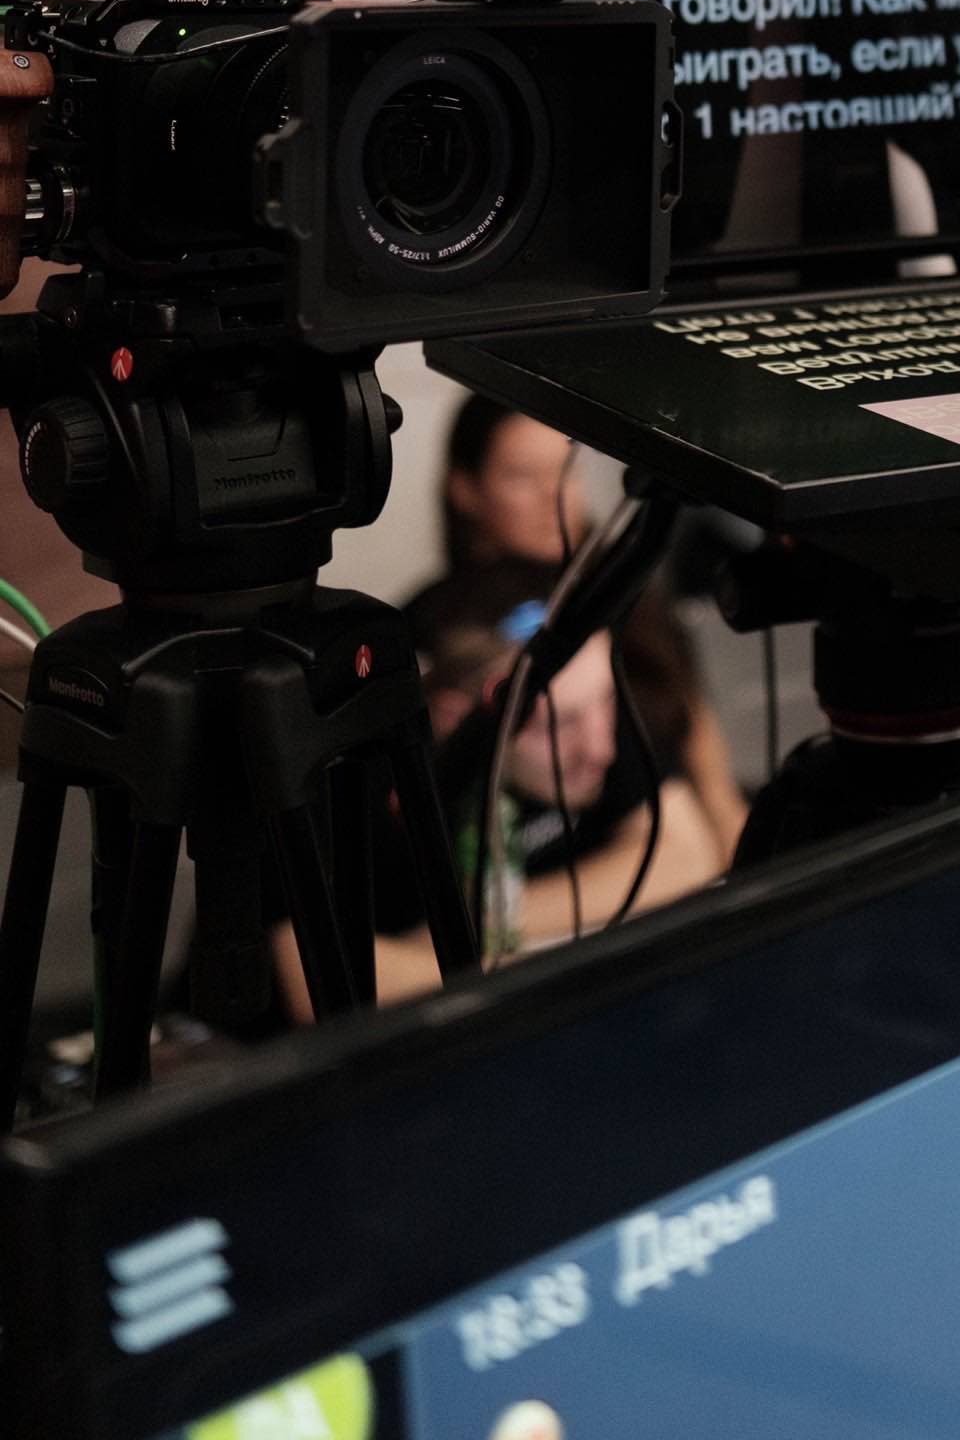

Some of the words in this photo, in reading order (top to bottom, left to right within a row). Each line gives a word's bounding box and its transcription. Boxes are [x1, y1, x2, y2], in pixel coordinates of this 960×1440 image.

[423, 56, 446, 65] LEICA
[674, 42, 841, 93] ыиграть,
[851, 36, 947, 74] если
[214, 467, 297, 491] Manfrotto
[47, 677, 105, 707] Manfrotto
[614, 1174, 774, 1306] Дарья
